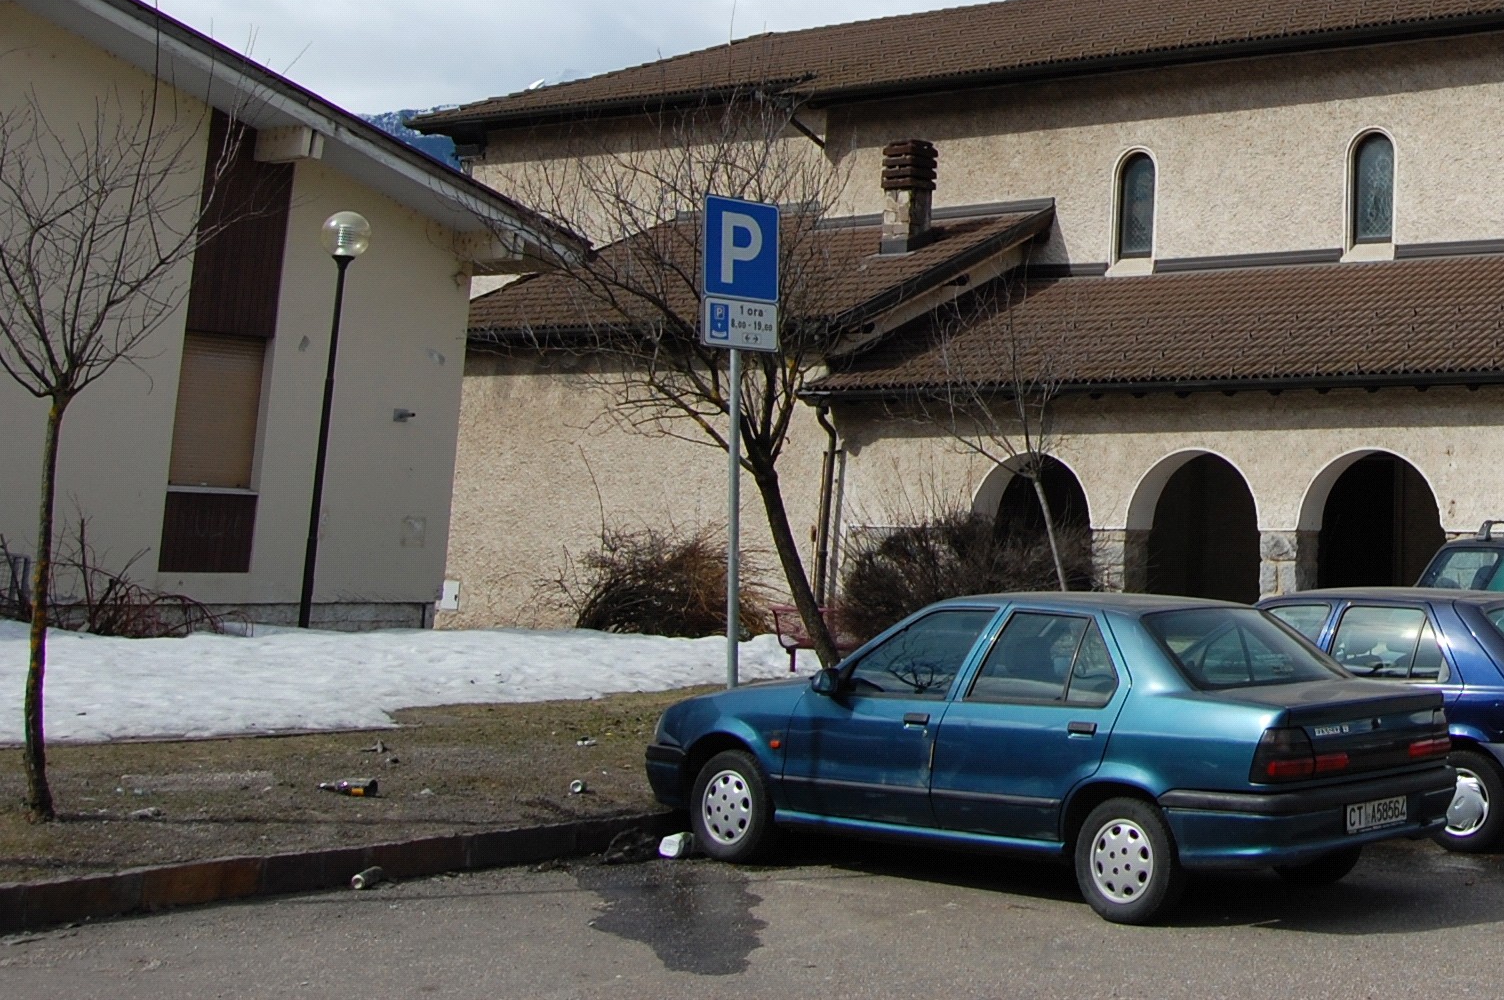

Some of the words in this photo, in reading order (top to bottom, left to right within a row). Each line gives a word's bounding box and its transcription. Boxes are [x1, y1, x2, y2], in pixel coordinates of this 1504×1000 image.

[721, 210, 763, 284] P
[716, 307, 723, 319] P
[747, 307, 764, 317] ora
[1349, 806, 1364, 827] CT
